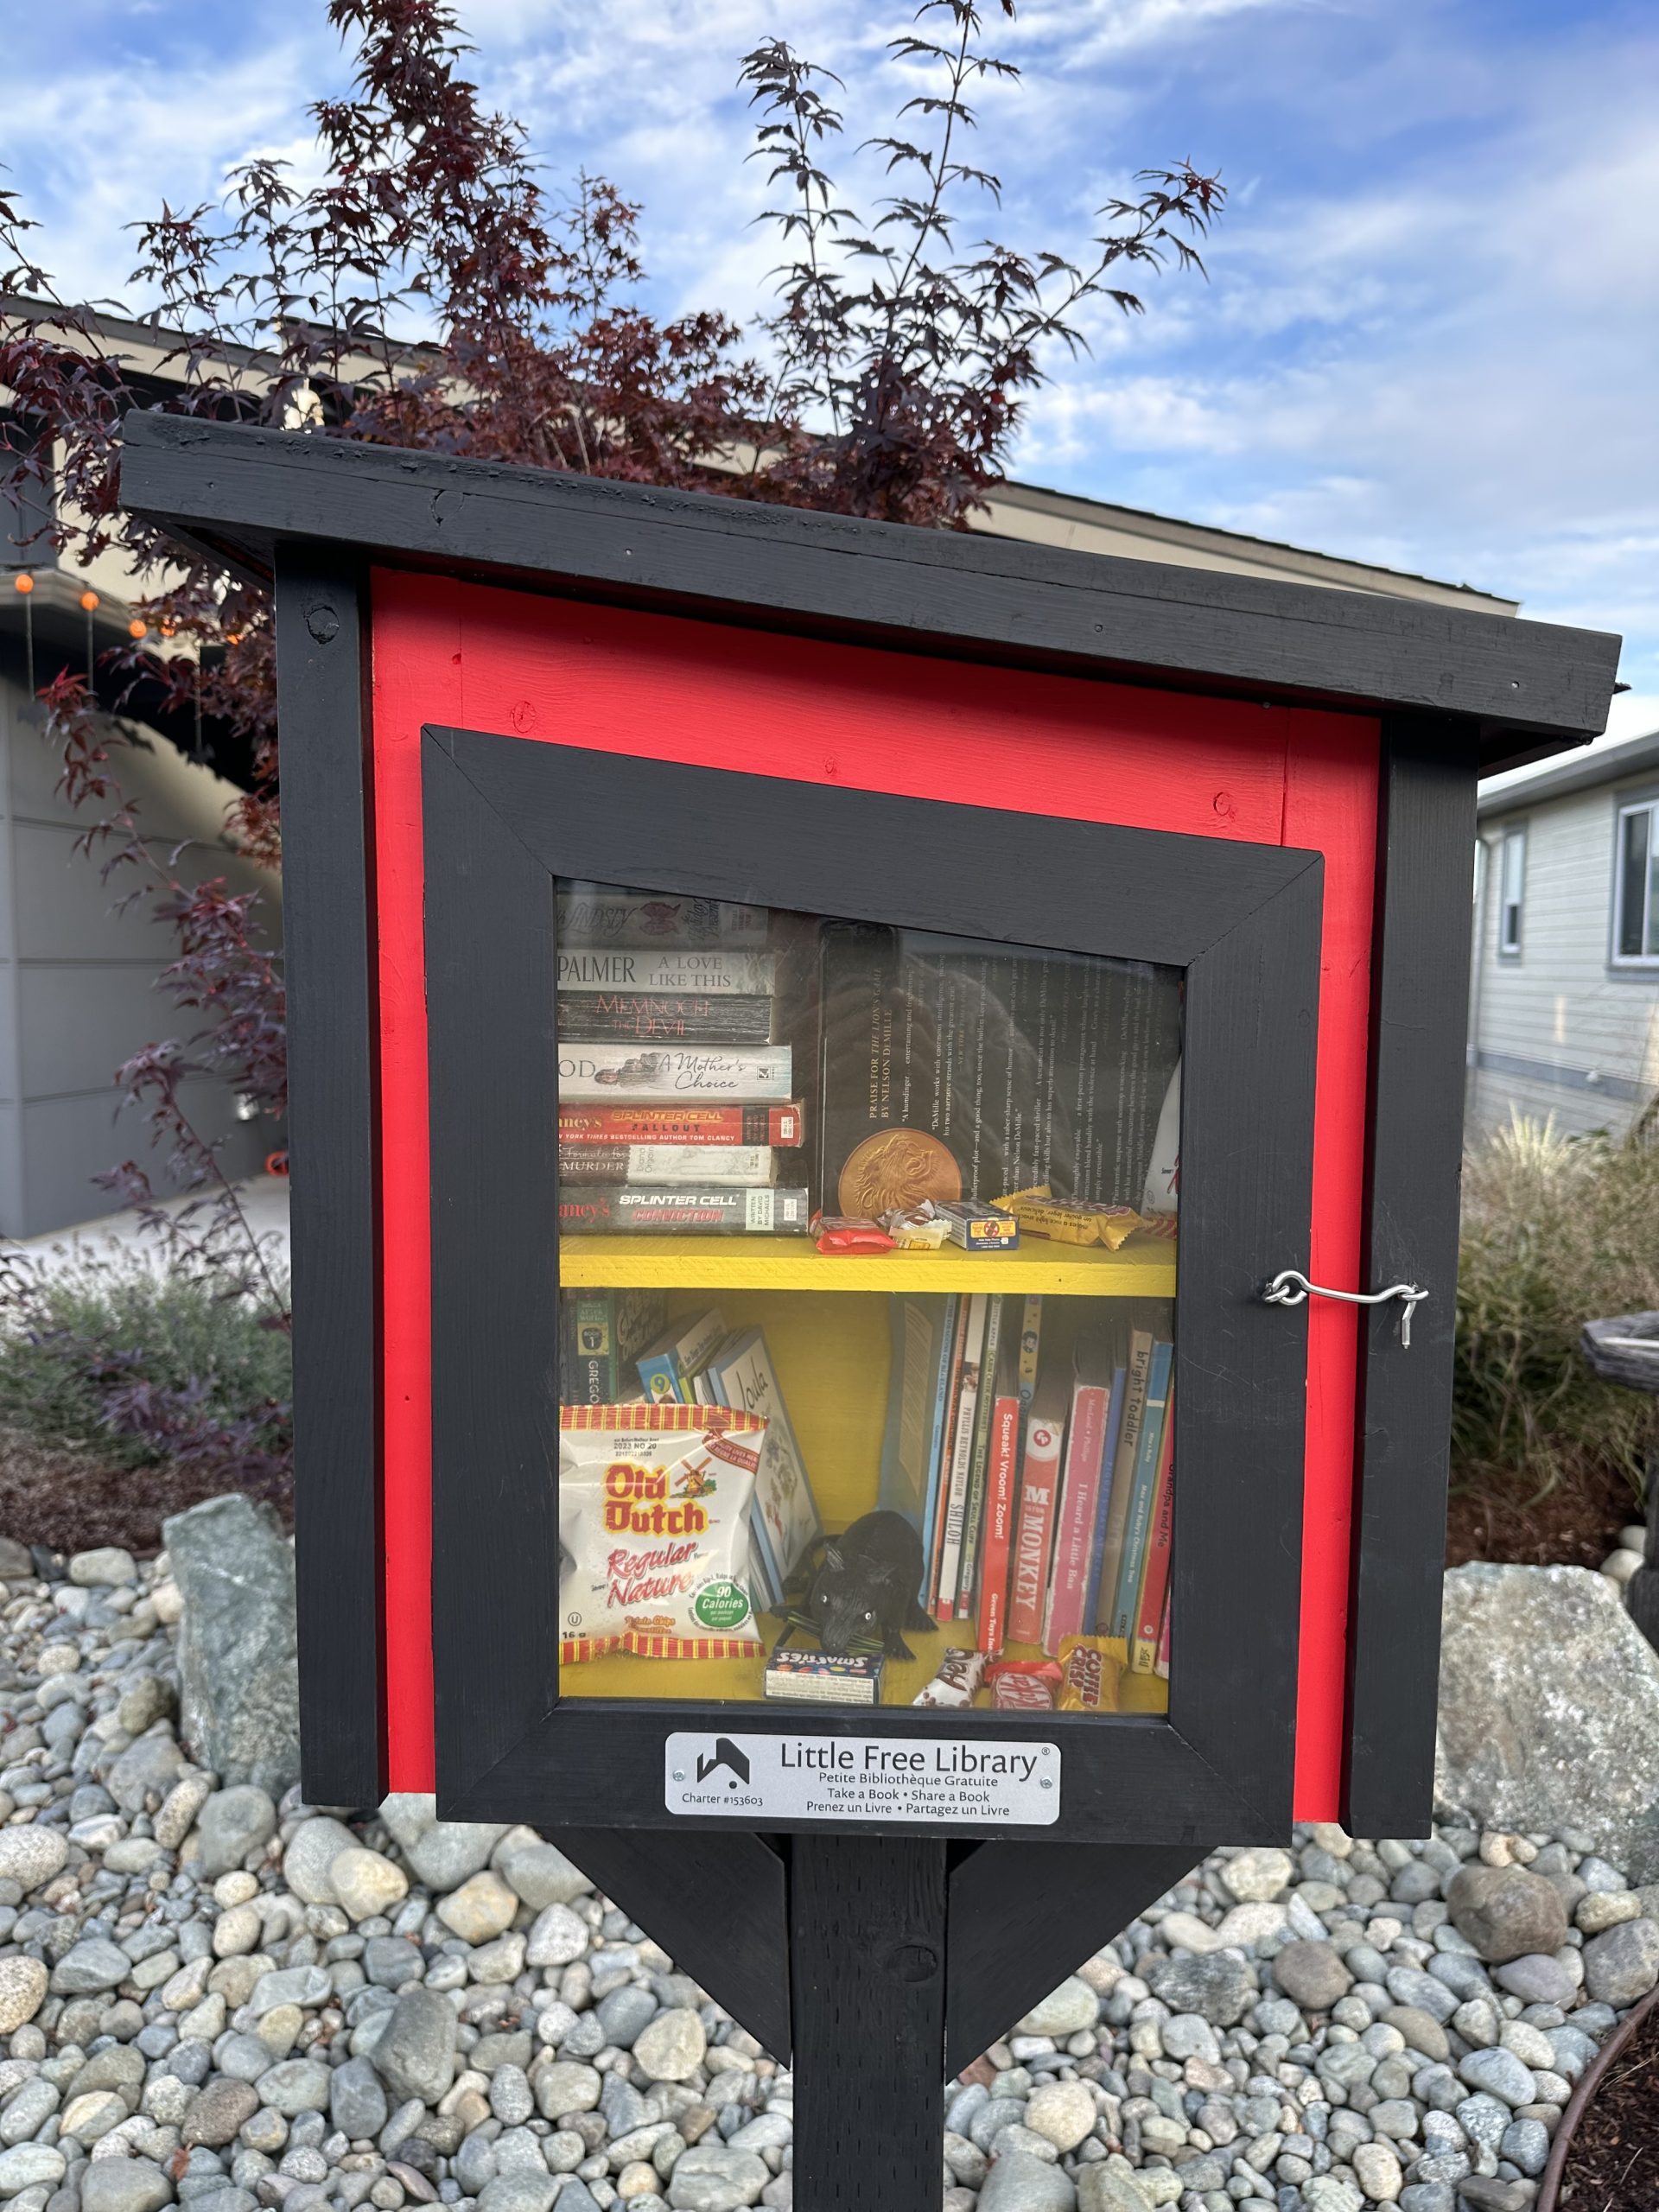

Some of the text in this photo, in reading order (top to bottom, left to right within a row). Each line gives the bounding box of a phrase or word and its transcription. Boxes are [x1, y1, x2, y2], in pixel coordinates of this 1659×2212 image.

[557, 956, 637, 982] PALMER
[658, 957, 722, 969] A LOVE
[649, 974, 732, 988] LIKE THIS
[594, 995, 710, 1017] MEMNOCH
[872, 999, 881, 1032] LION'S
[635, 1015, 685, 1036] DEVIL
[871, 1035, 880, 1054] THE
[658, 1053, 671, 1072] A
[674, 1052, 747, 1074] Mother's
[870, 1057, 880, 1079] FOR
[881, 1009, 893, 1119] BY NELSON DEMILLE
[944, 1058, 953, 1082] strands
[673, 1070, 739, 1090] Choice
[869, 1082, 879, 1119] PRAISE
[902, 1076, 912, 1112] humdinger
[612, 1109, 724, 1125] SPLINTER CELL
[974, 1107, 982, 1124] good
[1033, 1097, 1042, 1122] thriller
[632, 1124, 702, 1133] FALLOUT
[1032, 1123, 1042, 1157] fast-paced
[562, 1161, 625, 1172] MURDER
[1012, 1141, 1022, 1181] than Nelson
[619, 1194, 739, 1206] SPLINTER CELL
[631, 1209, 724, 1223] CONVICTION
[757, 1215, 764, 1224] BY
[653, 1376, 666, 1392] 9
[1123, 1351, 1149, 1447] bright toddler
[977, 1445, 986, 1459] THE
[605, 1464, 668, 1501] Old
[946, 1407, 972, 1546] PHYLLIS REYNOLDS NAYLOR SHILOH
[974, 1460, 984, 1489] LEGEND
[972, 1490, 980, 1500] OF
[1023, 1485, 1051, 1506] M
[969, 1501, 980, 1523] SKULL
[1075, 1490, 1088, 1524] Heard
[1137, 1500, 1146, 1513] and
[605, 1500, 706, 1535] Dutch
[988, 1413, 1013, 1637] Squeak! Vroom! Zoom! Green Toys
[1134, 1514, 1145, 1535] Ruby's
[1159, 1510, 1169, 1528] and
[967, 1524, 977, 1544] CLIFF
[1157, 1530, 1168, 1548] Me
[607, 1541, 698, 1580] Regular
[1069, 1535, 1082, 1566] Little
[1128, 1536, 1141, 1567] Christmas
[1015, 1513, 1046, 1611] MONKEY
[963, 1562, 974, 1591] Gregory
[1066, 1568, 1077, 1590] Baa
[1127, 1569, 1136, 1584] Tree
[716, 1586, 733, 1599] 90
[702, 1598, 745, 1610] Calories
[776, 1651, 869, 1668] SMARTIES
[1068, 1643, 1087, 1688] CRISP
[1082, 1649, 1103, 1707] COFFEE
[780, 1742, 1039, 1782] Little Free Library
[818, 1772, 998, 1789] Petite Bibliothèque Gratuite
[682, 1792, 764, 1807] Charter #153603
[827, 1788, 856, 1800] Take
[868, 1789, 899, 1801] Book
[912, 1789, 946, 1802] Share
[958, 1791, 990, 1802] Book
[806, 1802, 1010, 1818] Prenez un Livre Partagez un Livre
